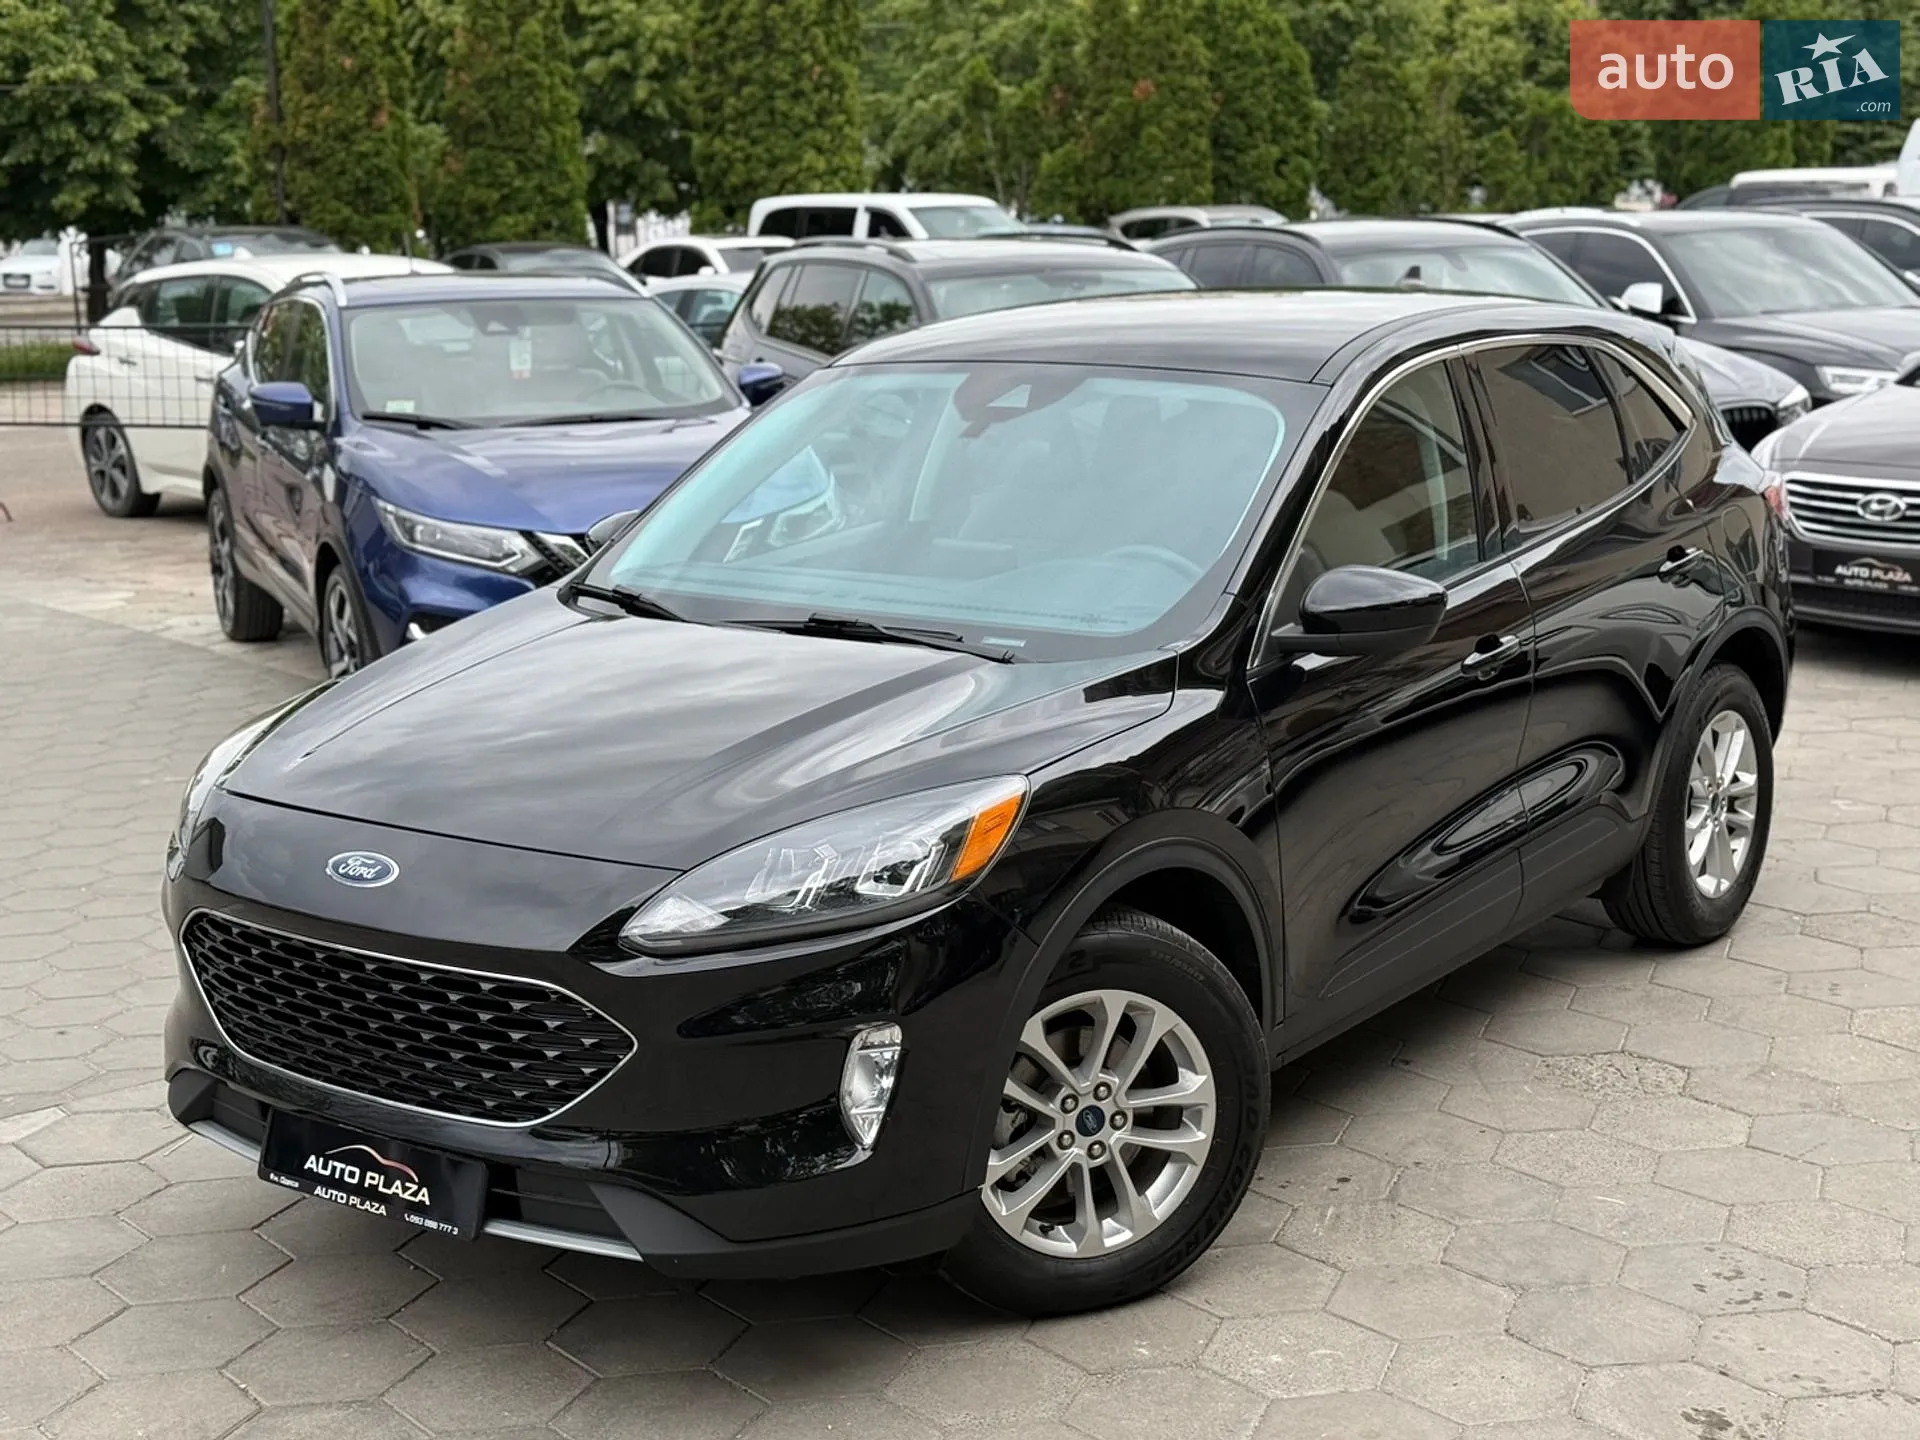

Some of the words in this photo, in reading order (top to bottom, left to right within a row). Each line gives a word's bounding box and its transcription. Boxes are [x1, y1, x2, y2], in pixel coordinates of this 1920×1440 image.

[1835, 564, 1870, 578] AUTO
[1871, 568, 1912, 582] PLAZA
[338, 856, 382, 879] Ford
[303, 1154, 360, 1185] AUTO
[363, 1170, 431, 1206] PLAZA
[313, 1185, 347, 1204] AUTO
[348, 1195, 387, 1217] PLAZA
